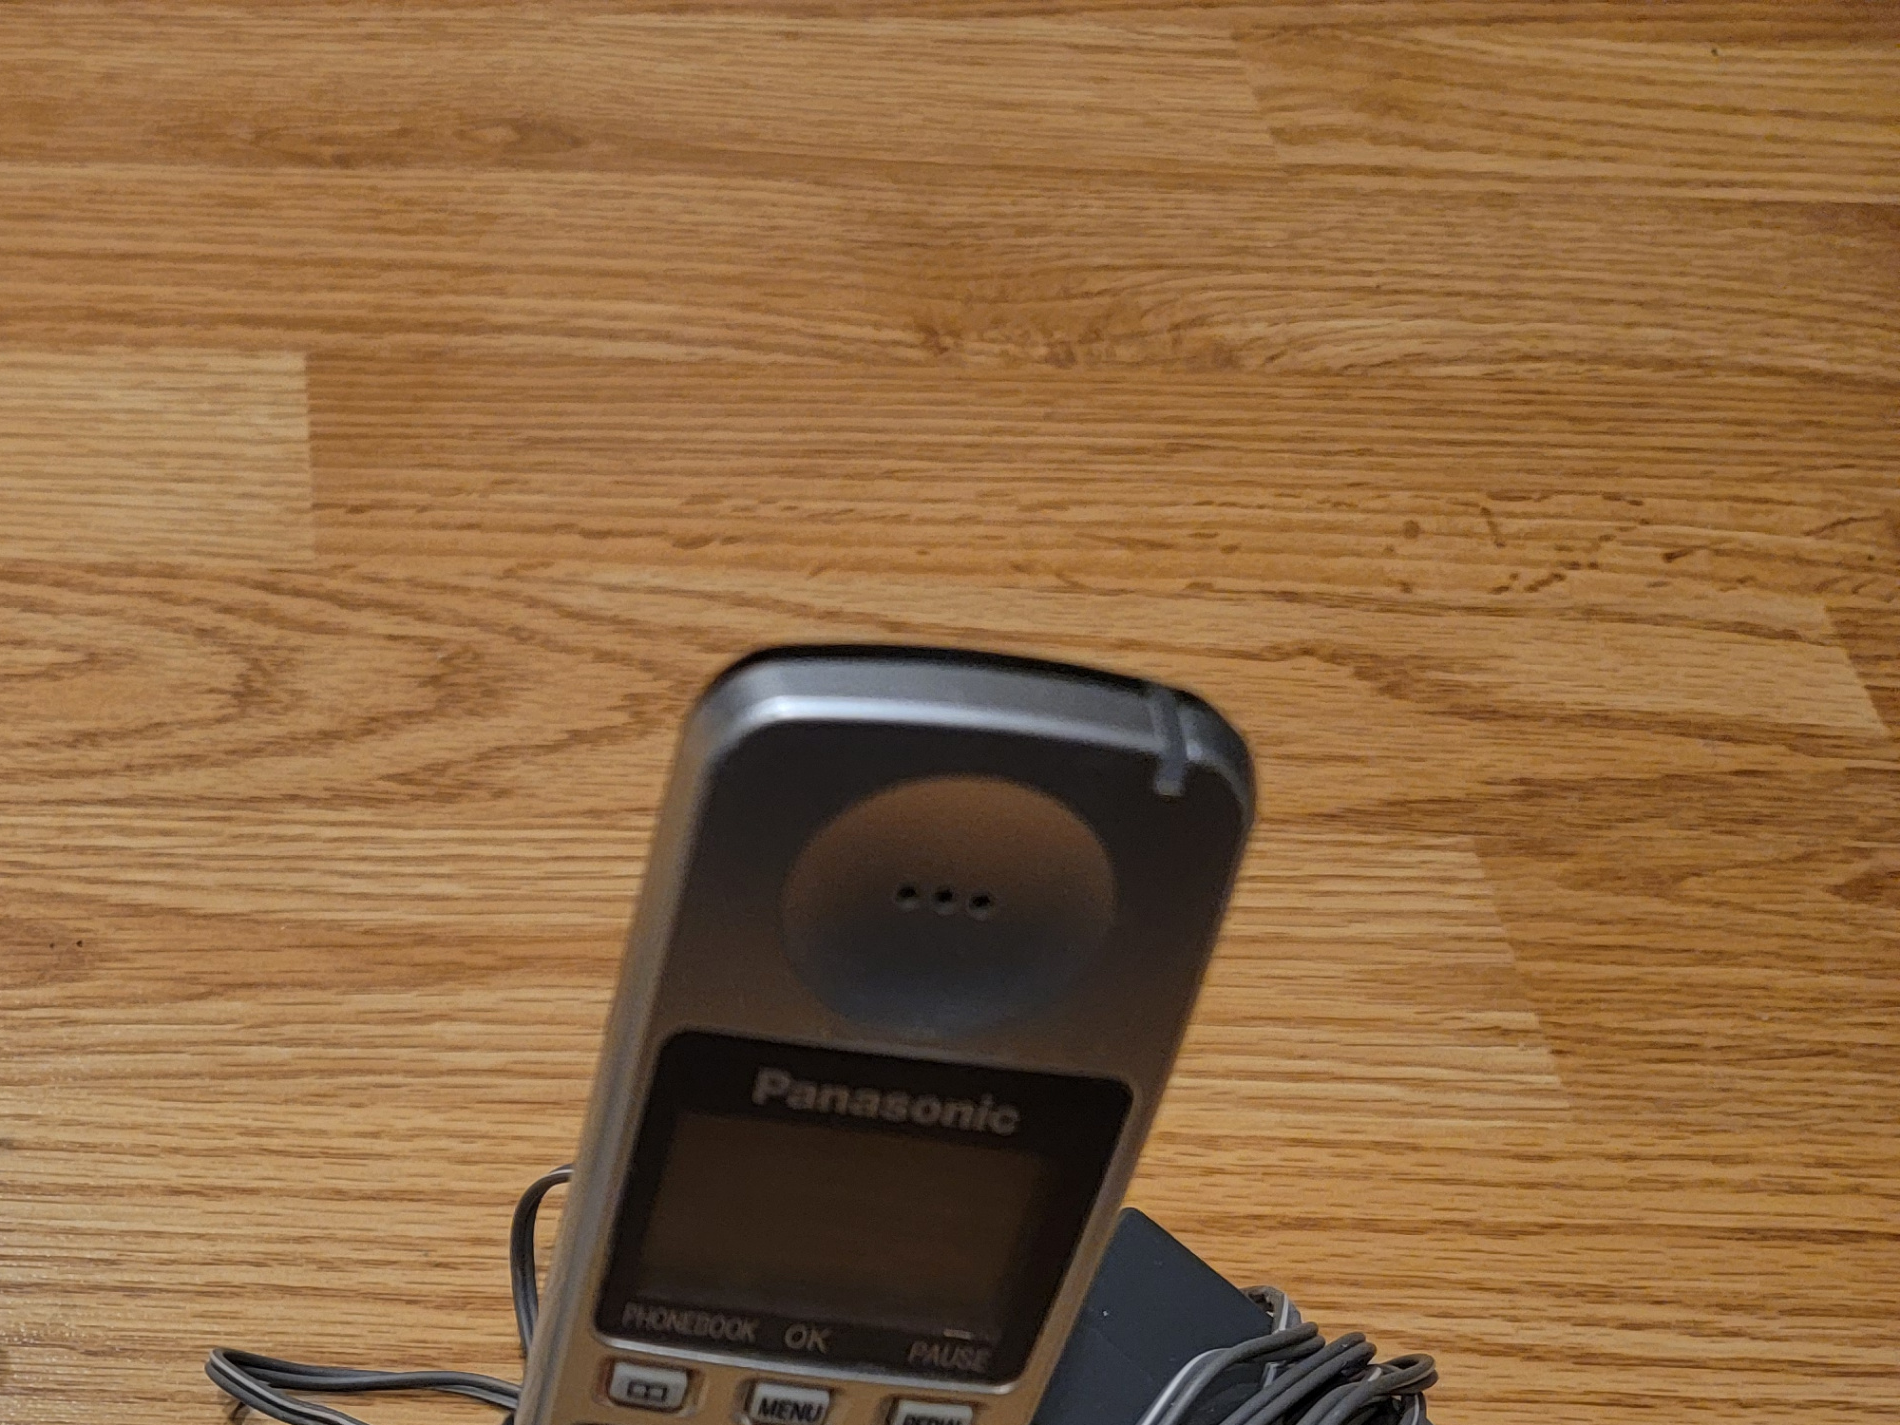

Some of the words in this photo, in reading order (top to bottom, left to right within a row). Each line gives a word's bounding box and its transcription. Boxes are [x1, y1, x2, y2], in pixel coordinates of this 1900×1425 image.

[750, 1066, 1022, 1138] Panasonic
[620, 1301, 760, 1344] PHONEBOOK
[784, 1324, 833, 1355] OK
[908, 1340, 992, 1374] PAUSE
[758, 1396, 824, 1424] MENU
